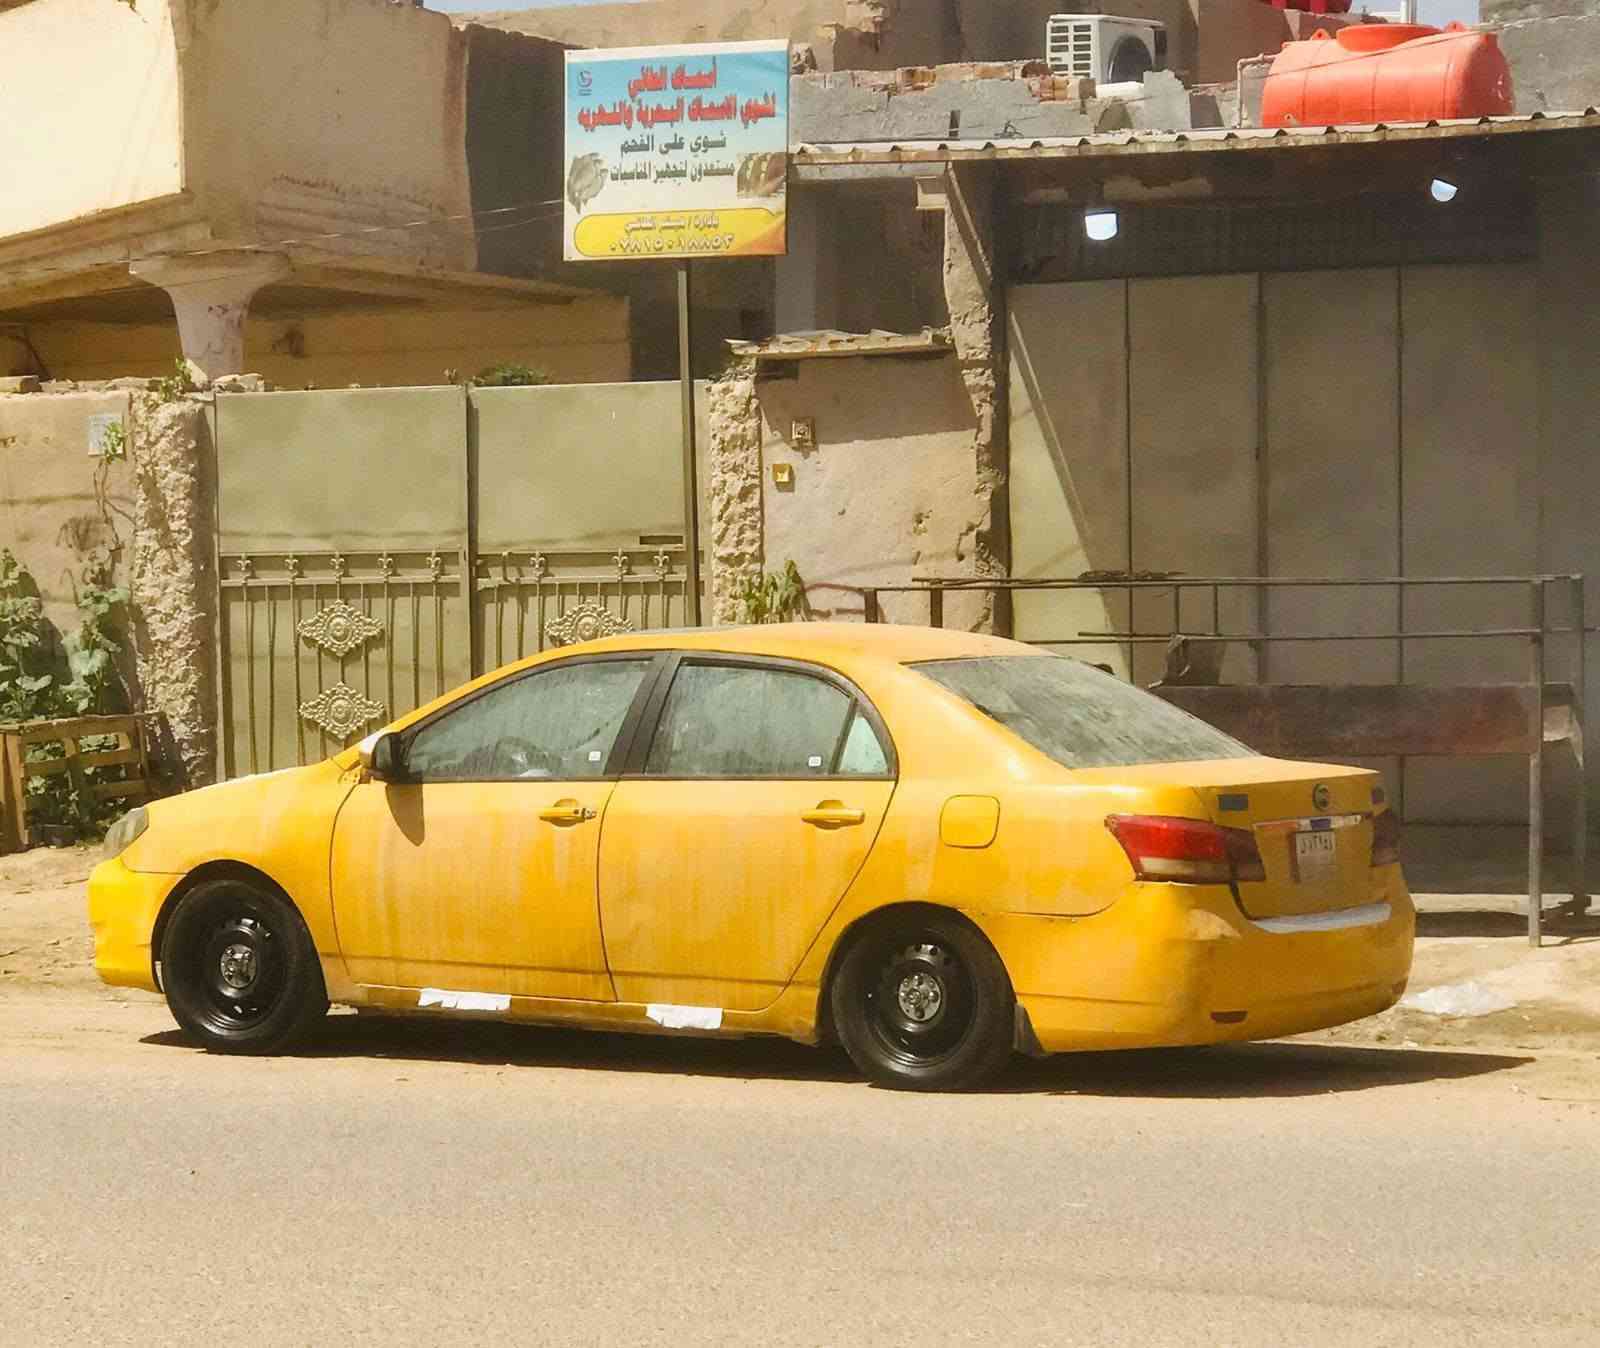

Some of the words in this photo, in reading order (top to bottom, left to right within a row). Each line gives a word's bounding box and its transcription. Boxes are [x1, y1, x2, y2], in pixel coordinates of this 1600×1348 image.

[671, 56, 717, 89] أسماك
[620, 133, 655, 159] الفحم
[659, 132, 685, 154] على
[610, 160, 652, 184] المناسبات
[654, 159, 688, 186] لتجهيز
[690, 160, 736, 182] مستعدون
